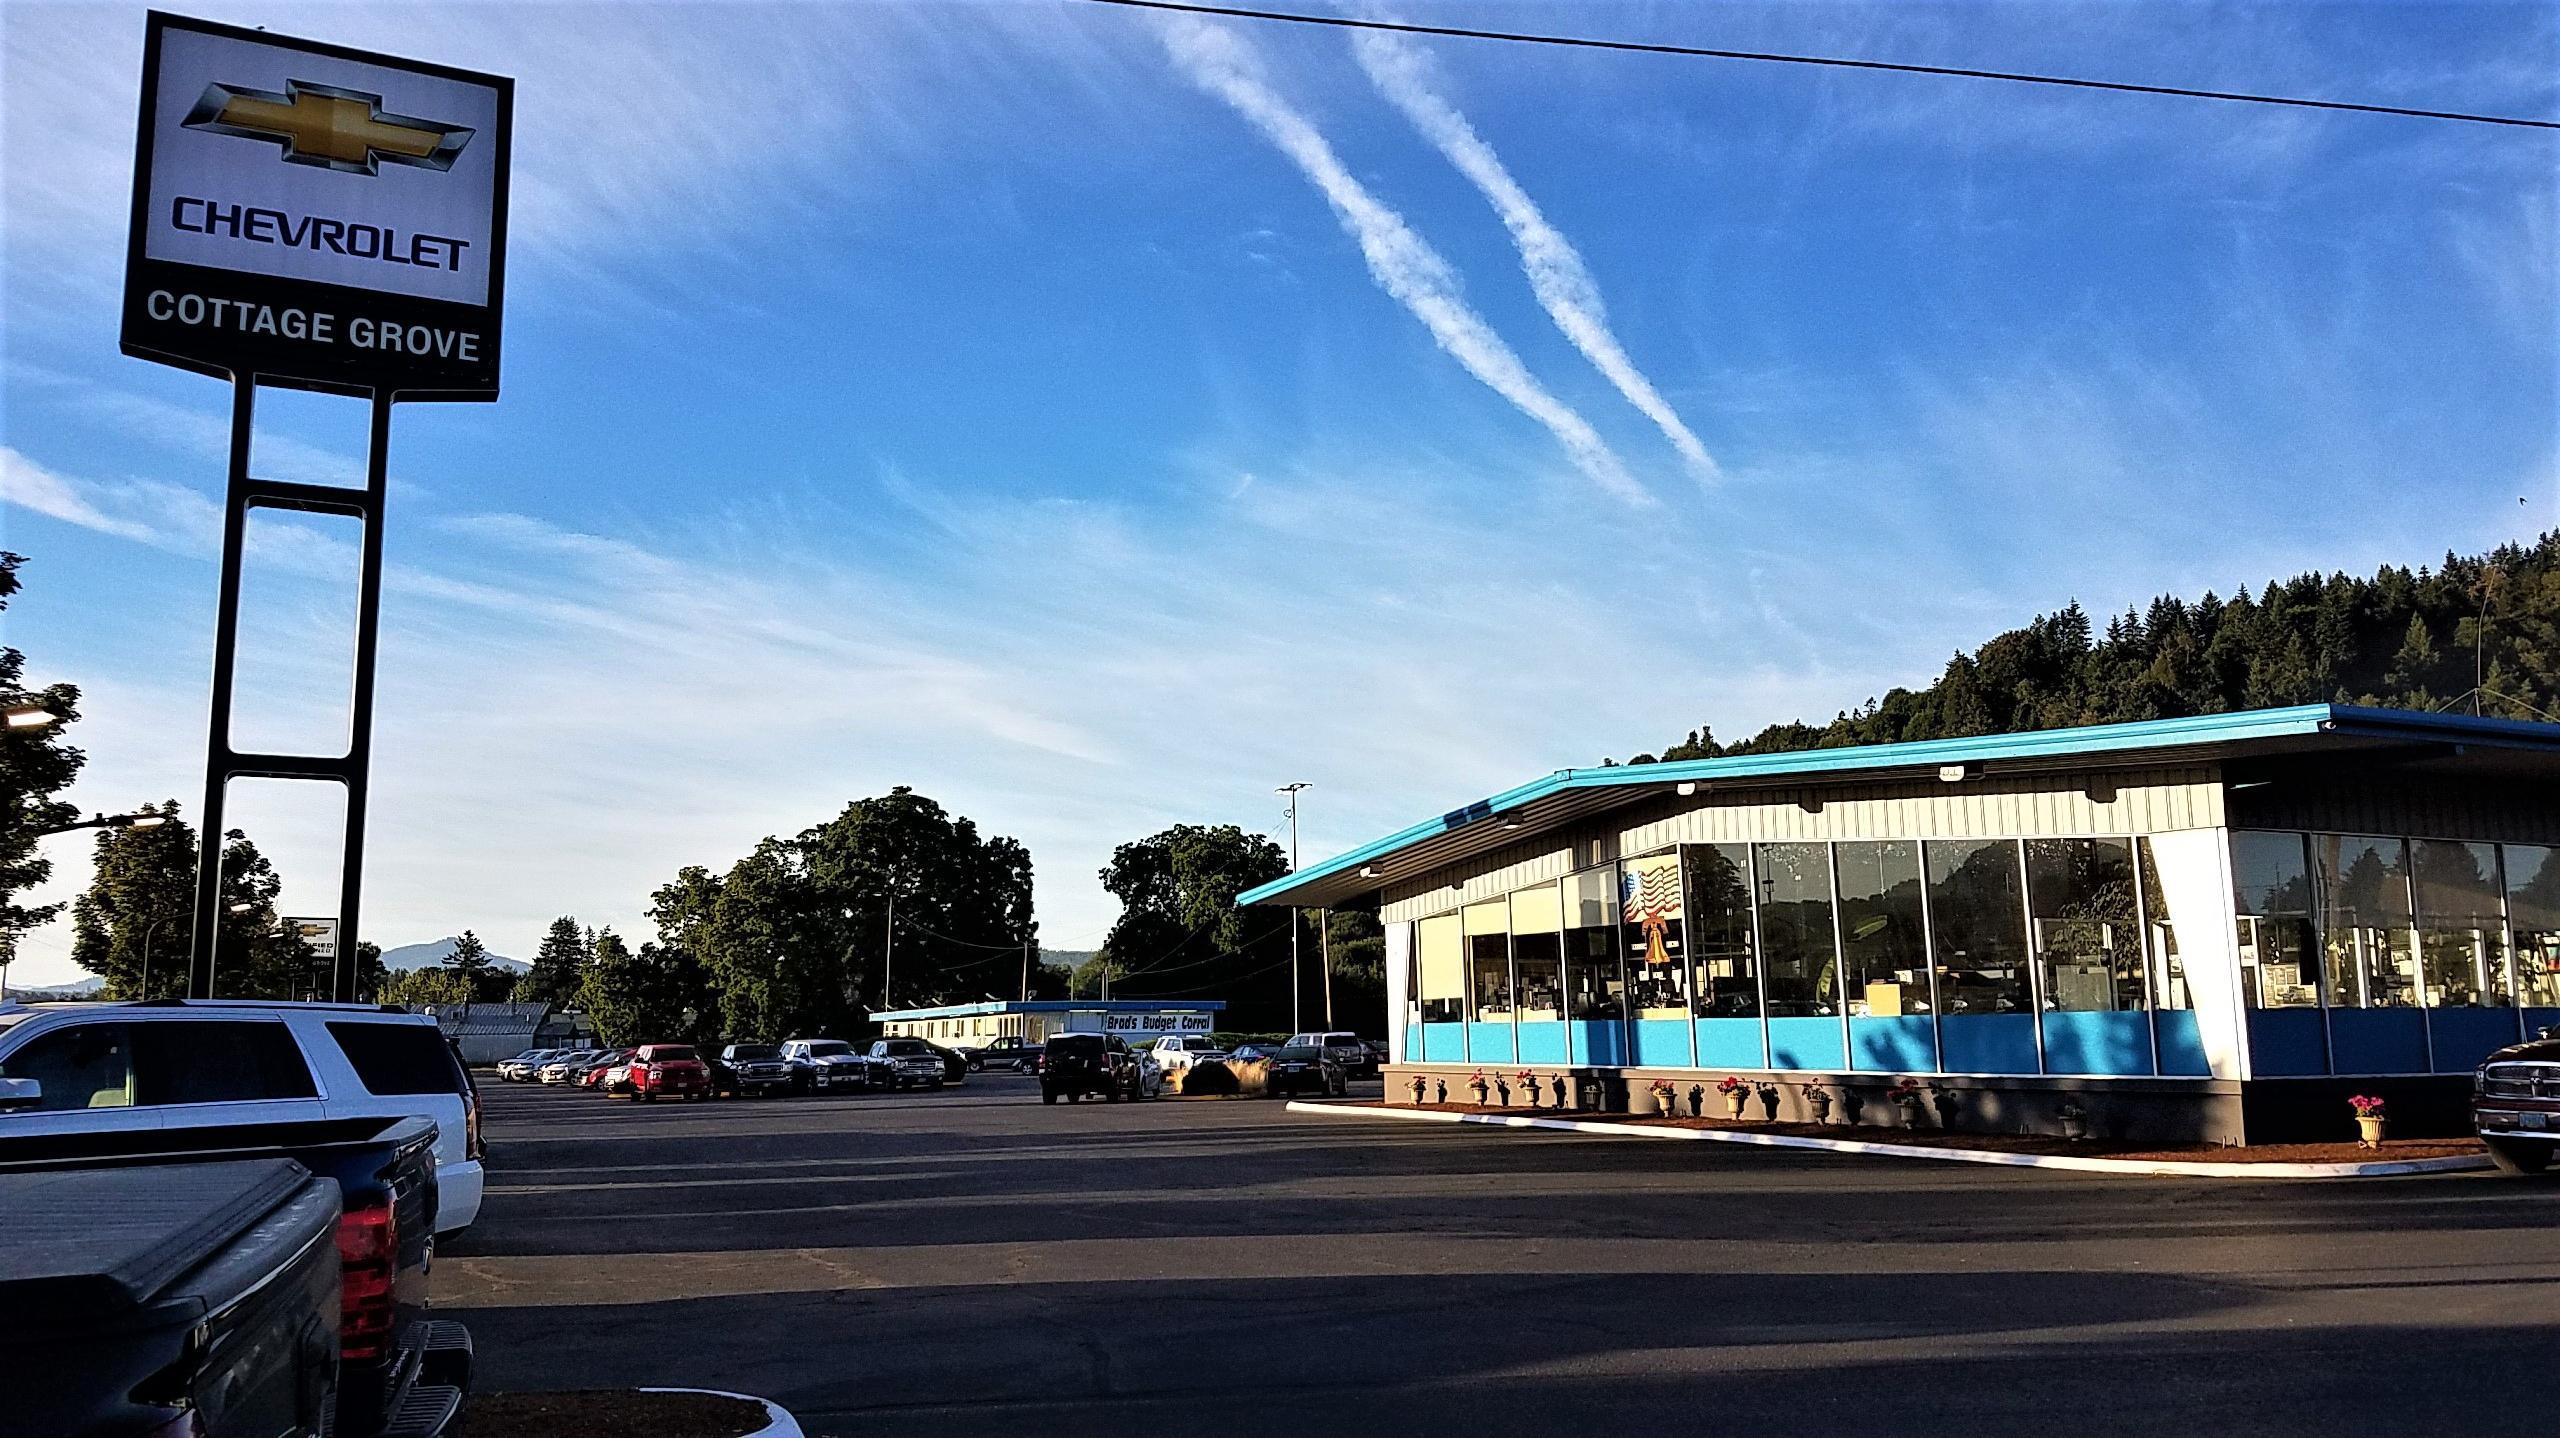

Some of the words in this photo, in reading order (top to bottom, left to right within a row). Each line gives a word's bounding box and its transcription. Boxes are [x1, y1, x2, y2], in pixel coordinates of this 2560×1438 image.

[171, 196, 470, 272] CHEVROLET
[147, 290, 335, 343] COTTAGE
[349, 317, 480, 362] GROVE
[1142, 1015, 1177, 1032] Budget
[1181, 1015, 1211, 1030] Corral
